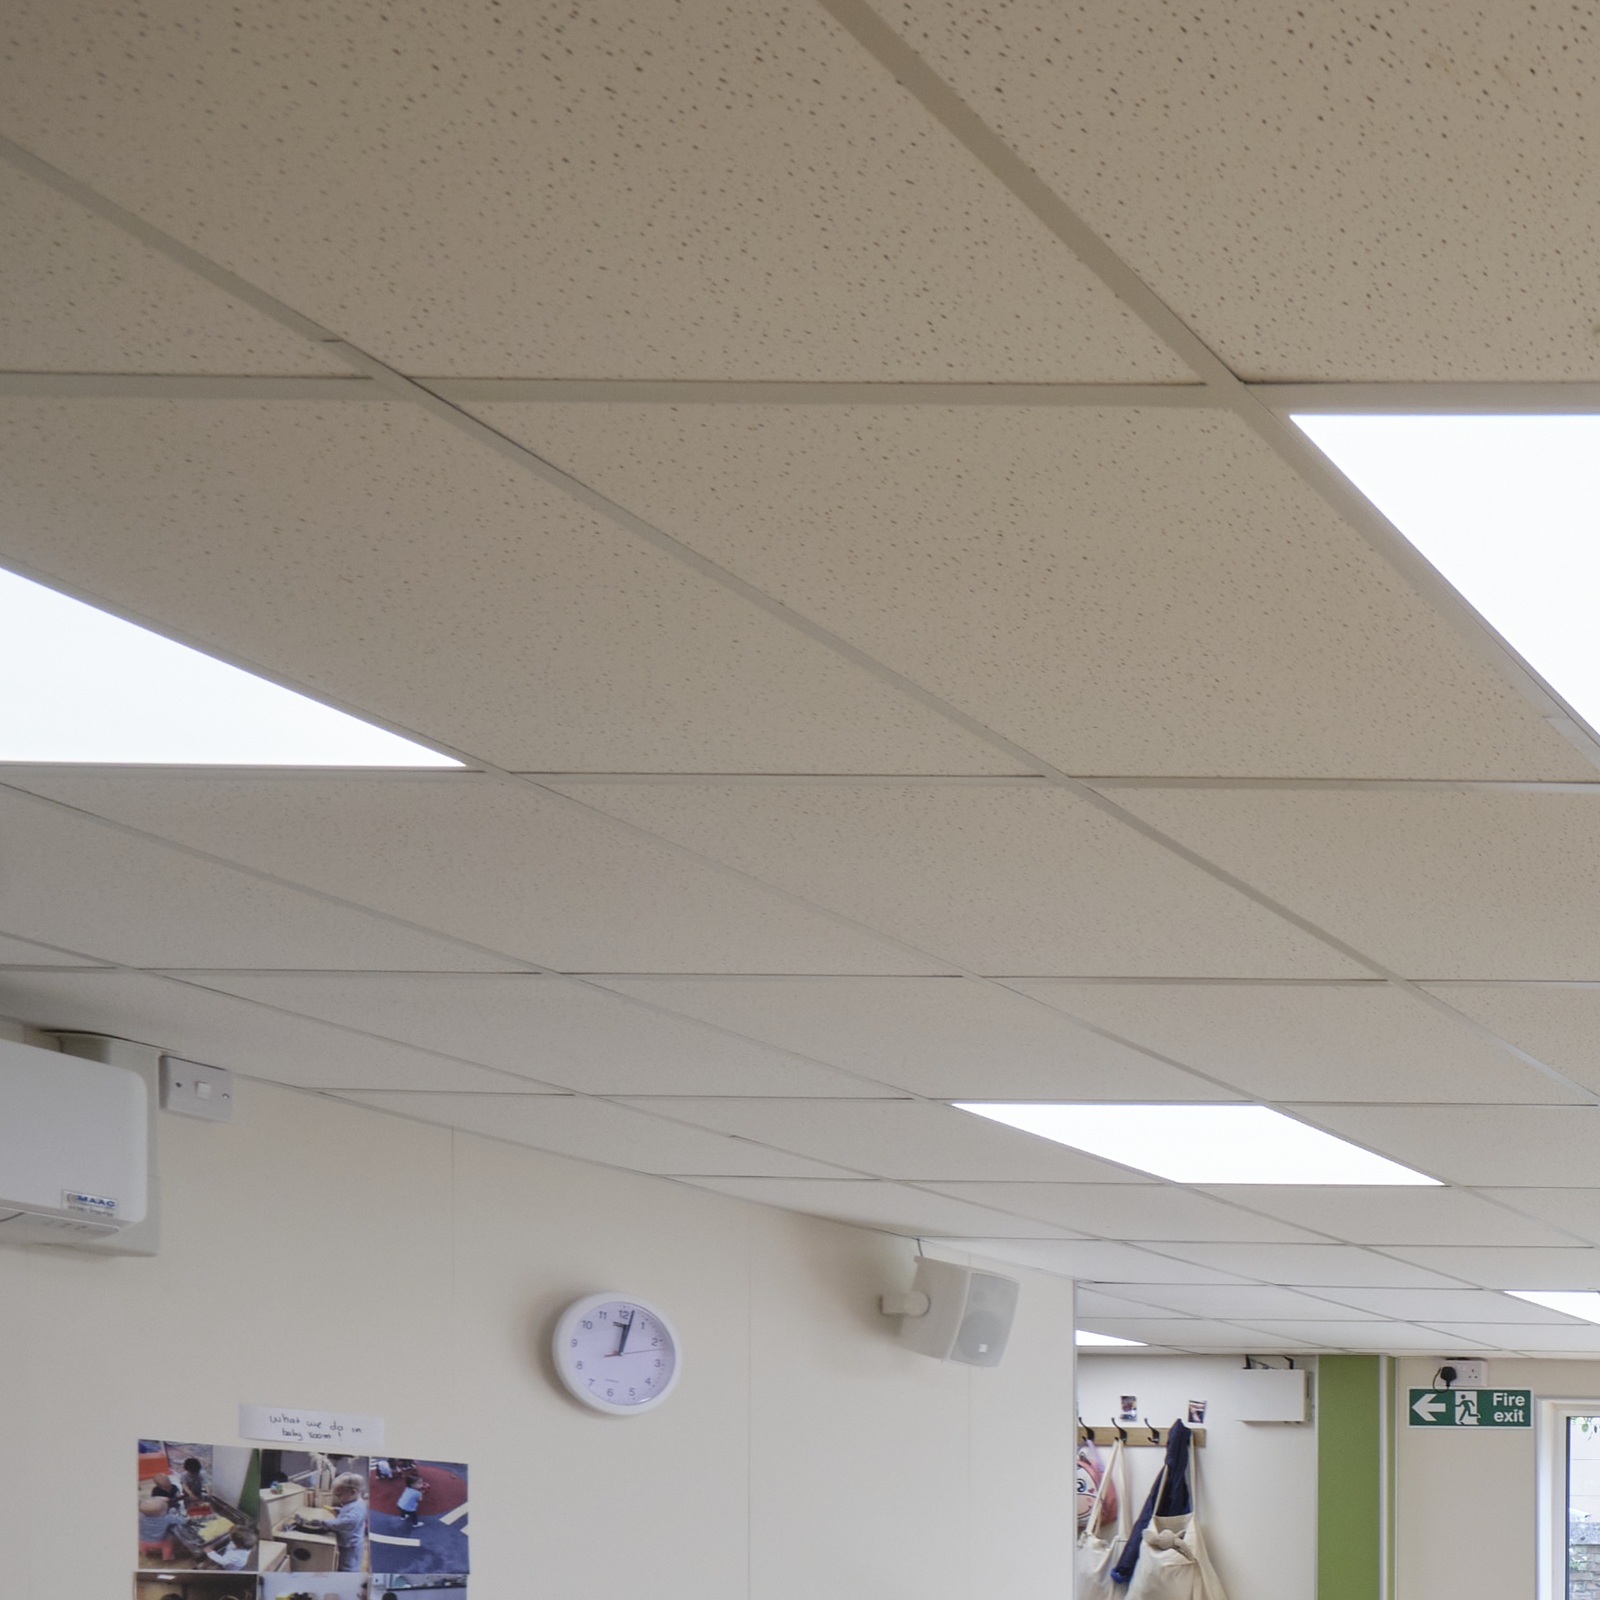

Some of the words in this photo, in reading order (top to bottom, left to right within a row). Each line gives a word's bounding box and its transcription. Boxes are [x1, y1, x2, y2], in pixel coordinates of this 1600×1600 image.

[77, 1195, 116, 1207] MAAC
[599, 1311, 607, 1320] 11
[618, 1310, 630, 1320] 12
[581, 1320, 593, 1330] 10
[571, 1338, 578, 1348] 9
[651, 1337, 659, 1347] 2
[576, 1361, 583, 1370] 8
[654, 1359, 661, 1368] 3
[588, 1378, 595, 1387] 7
[644, 1377, 651, 1385] 4
[607, 1388, 614, 1397] 6
[629, 1387, 636, 1397] 5
[1493, 1392, 1525, 1406] Fire
[1493, 1409, 1525, 1422] exit
[329, 1421, 344, 1431] do
